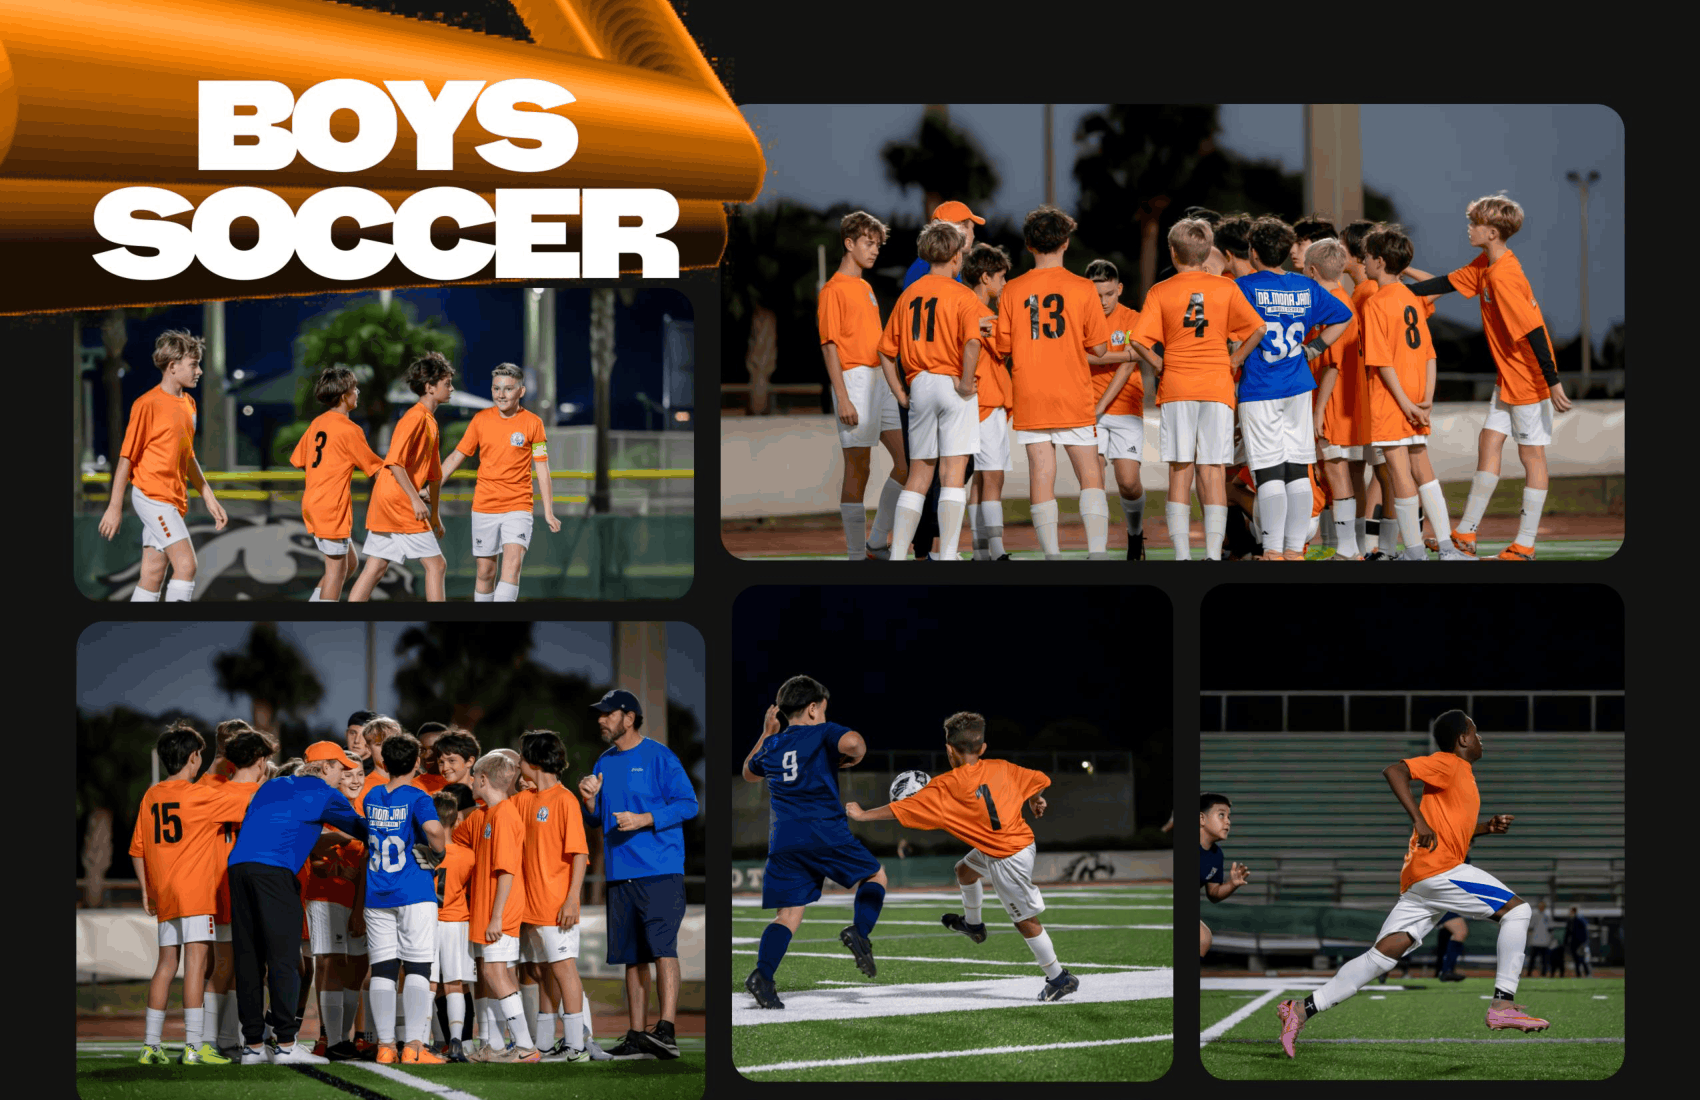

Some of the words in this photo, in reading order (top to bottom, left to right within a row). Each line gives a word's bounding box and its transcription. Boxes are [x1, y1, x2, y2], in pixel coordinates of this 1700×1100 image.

[909, 296, 938, 342] 11
[1024, 293, 1066, 340] 13
[1183, 292, 1209, 337] 4
[1404, 305, 1421, 350] 8
[312, 431, 327, 468] 3
[782, 750, 798, 782] 9
[150, 801, 183, 844] 15
[975, 784, 1002, 831] 1
[367, 834, 407, 873] 30
